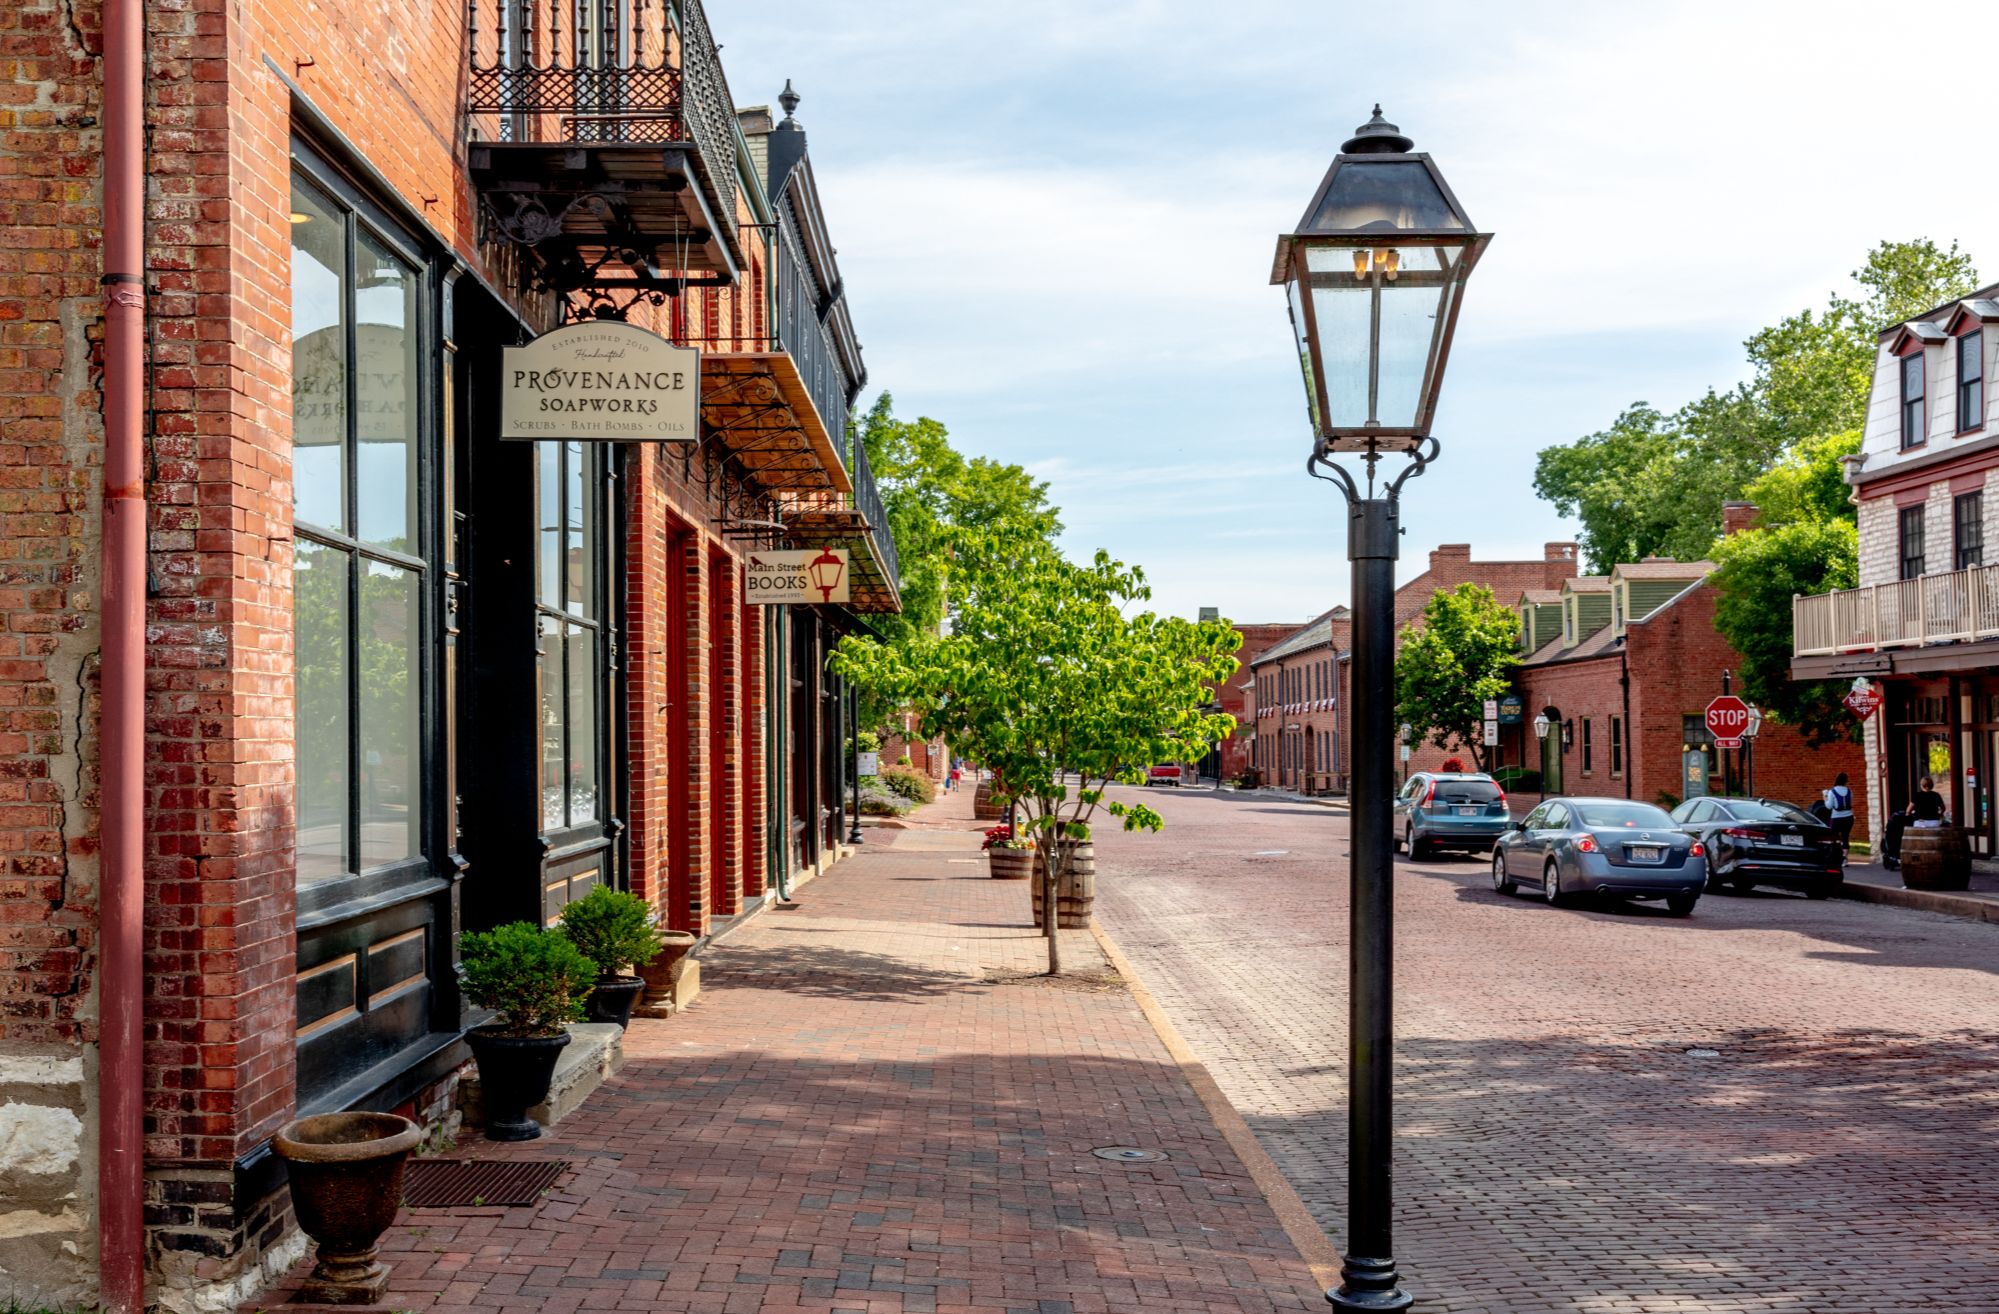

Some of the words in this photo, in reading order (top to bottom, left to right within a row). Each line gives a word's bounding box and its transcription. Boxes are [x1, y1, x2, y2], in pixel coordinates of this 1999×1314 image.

[552, 334, 621, 351] ESTABLISHED
[626, 339, 649, 352] 2010
[574, 348, 625, 362] Handcrafted
[513, 368, 685, 392] PROVENANCE
[539, 398, 658, 415] SOAPWORKS
[513, 420, 556, 431] SCRUBS
[571, 421, 600, 431] BATH
[605, 421, 643, 432] BOMBS
[657, 421, 685, 432] OILS
[748, 563, 774, 572] Main
[777, 563, 807, 572] Street
[748, 576, 807, 590] BOOKS
[1708, 709, 1747, 726] STOP
